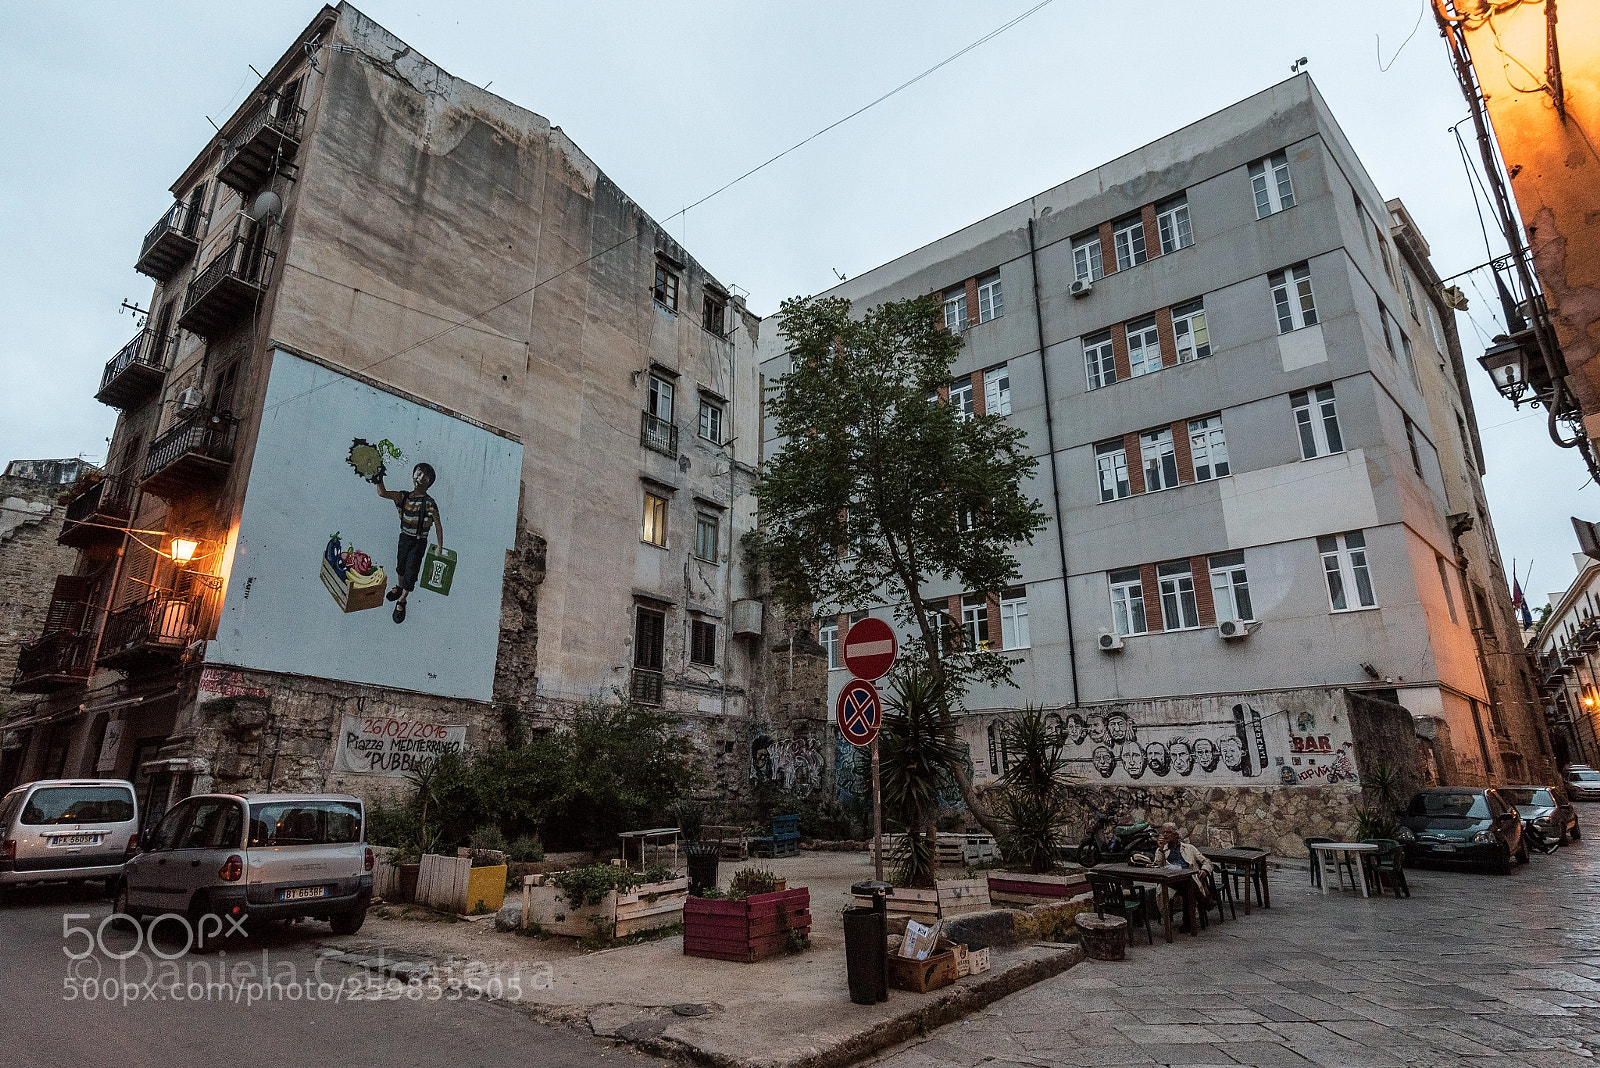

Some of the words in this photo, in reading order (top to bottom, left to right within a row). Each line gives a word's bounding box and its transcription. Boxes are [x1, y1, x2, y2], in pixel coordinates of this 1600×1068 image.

[362, 719, 448, 739] 26/02/2016
[346, 732, 384, 751] Piazza
[390, 738, 460, 753] MEDITERRANEO
[1292, 735, 1332, 751] BAR
[286, 889, 297, 899] BY
